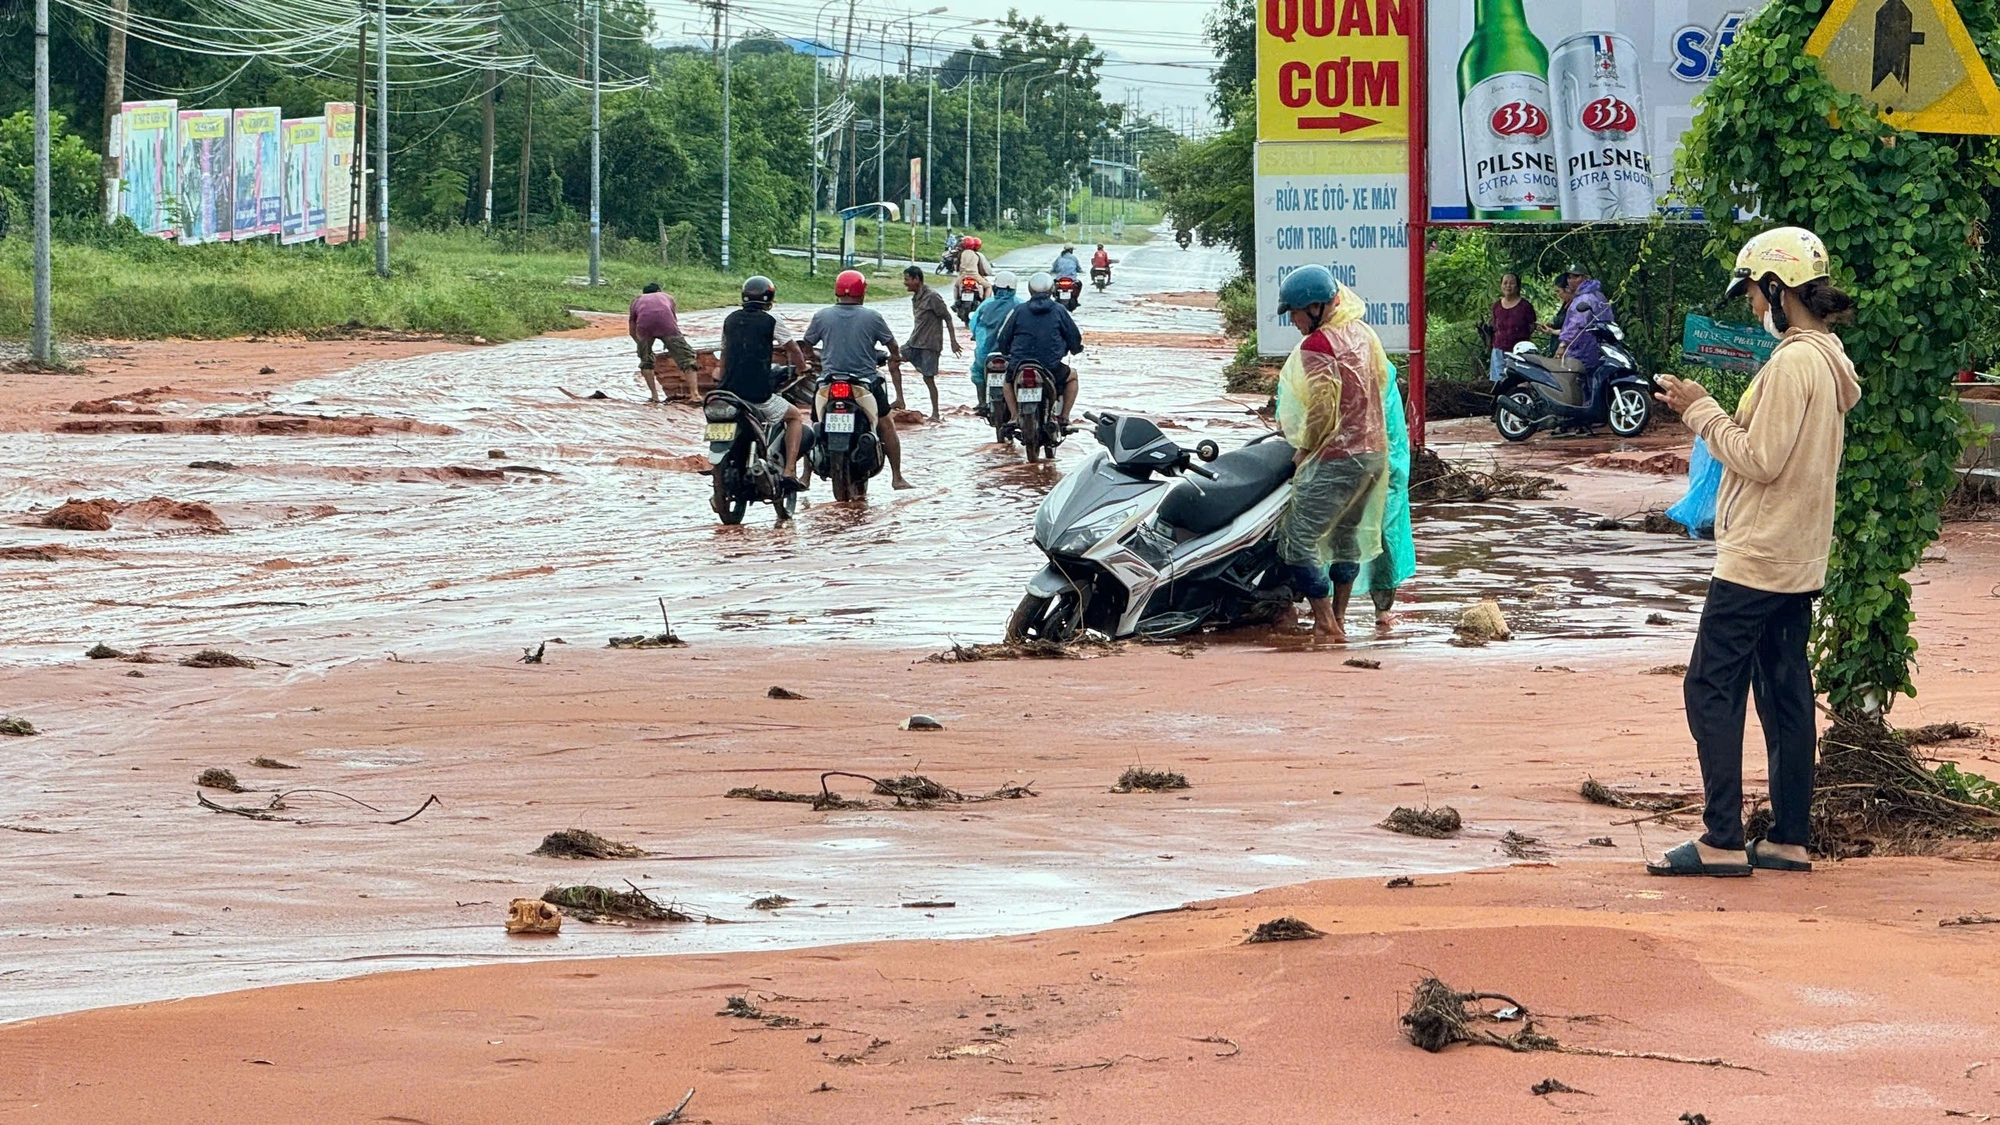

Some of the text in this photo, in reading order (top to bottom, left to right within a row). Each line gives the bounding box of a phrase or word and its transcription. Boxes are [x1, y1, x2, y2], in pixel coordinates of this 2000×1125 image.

[1279, 56, 1400, 108] CƠM
[1500, 99, 1539, 132] 333
[1589, 94, 1628, 128] 333
[1477, 152, 1558, 180] PILSNE
[1478, 173, 1519, 195] EXTRA
[1570, 170, 1609, 192] EXTRA
[1276, 181, 1300, 211] RỬA
[1303, 188, 1318, 211] XE
[1353, 187, 1368, 210] XE
[1371, 182, 1397, 210] MÁY
[1277, 225, 1304, 250] CƠM
[1307, 224, 1338, 249] TRƯA
[1350, 224, 1376, 249] CƠM
